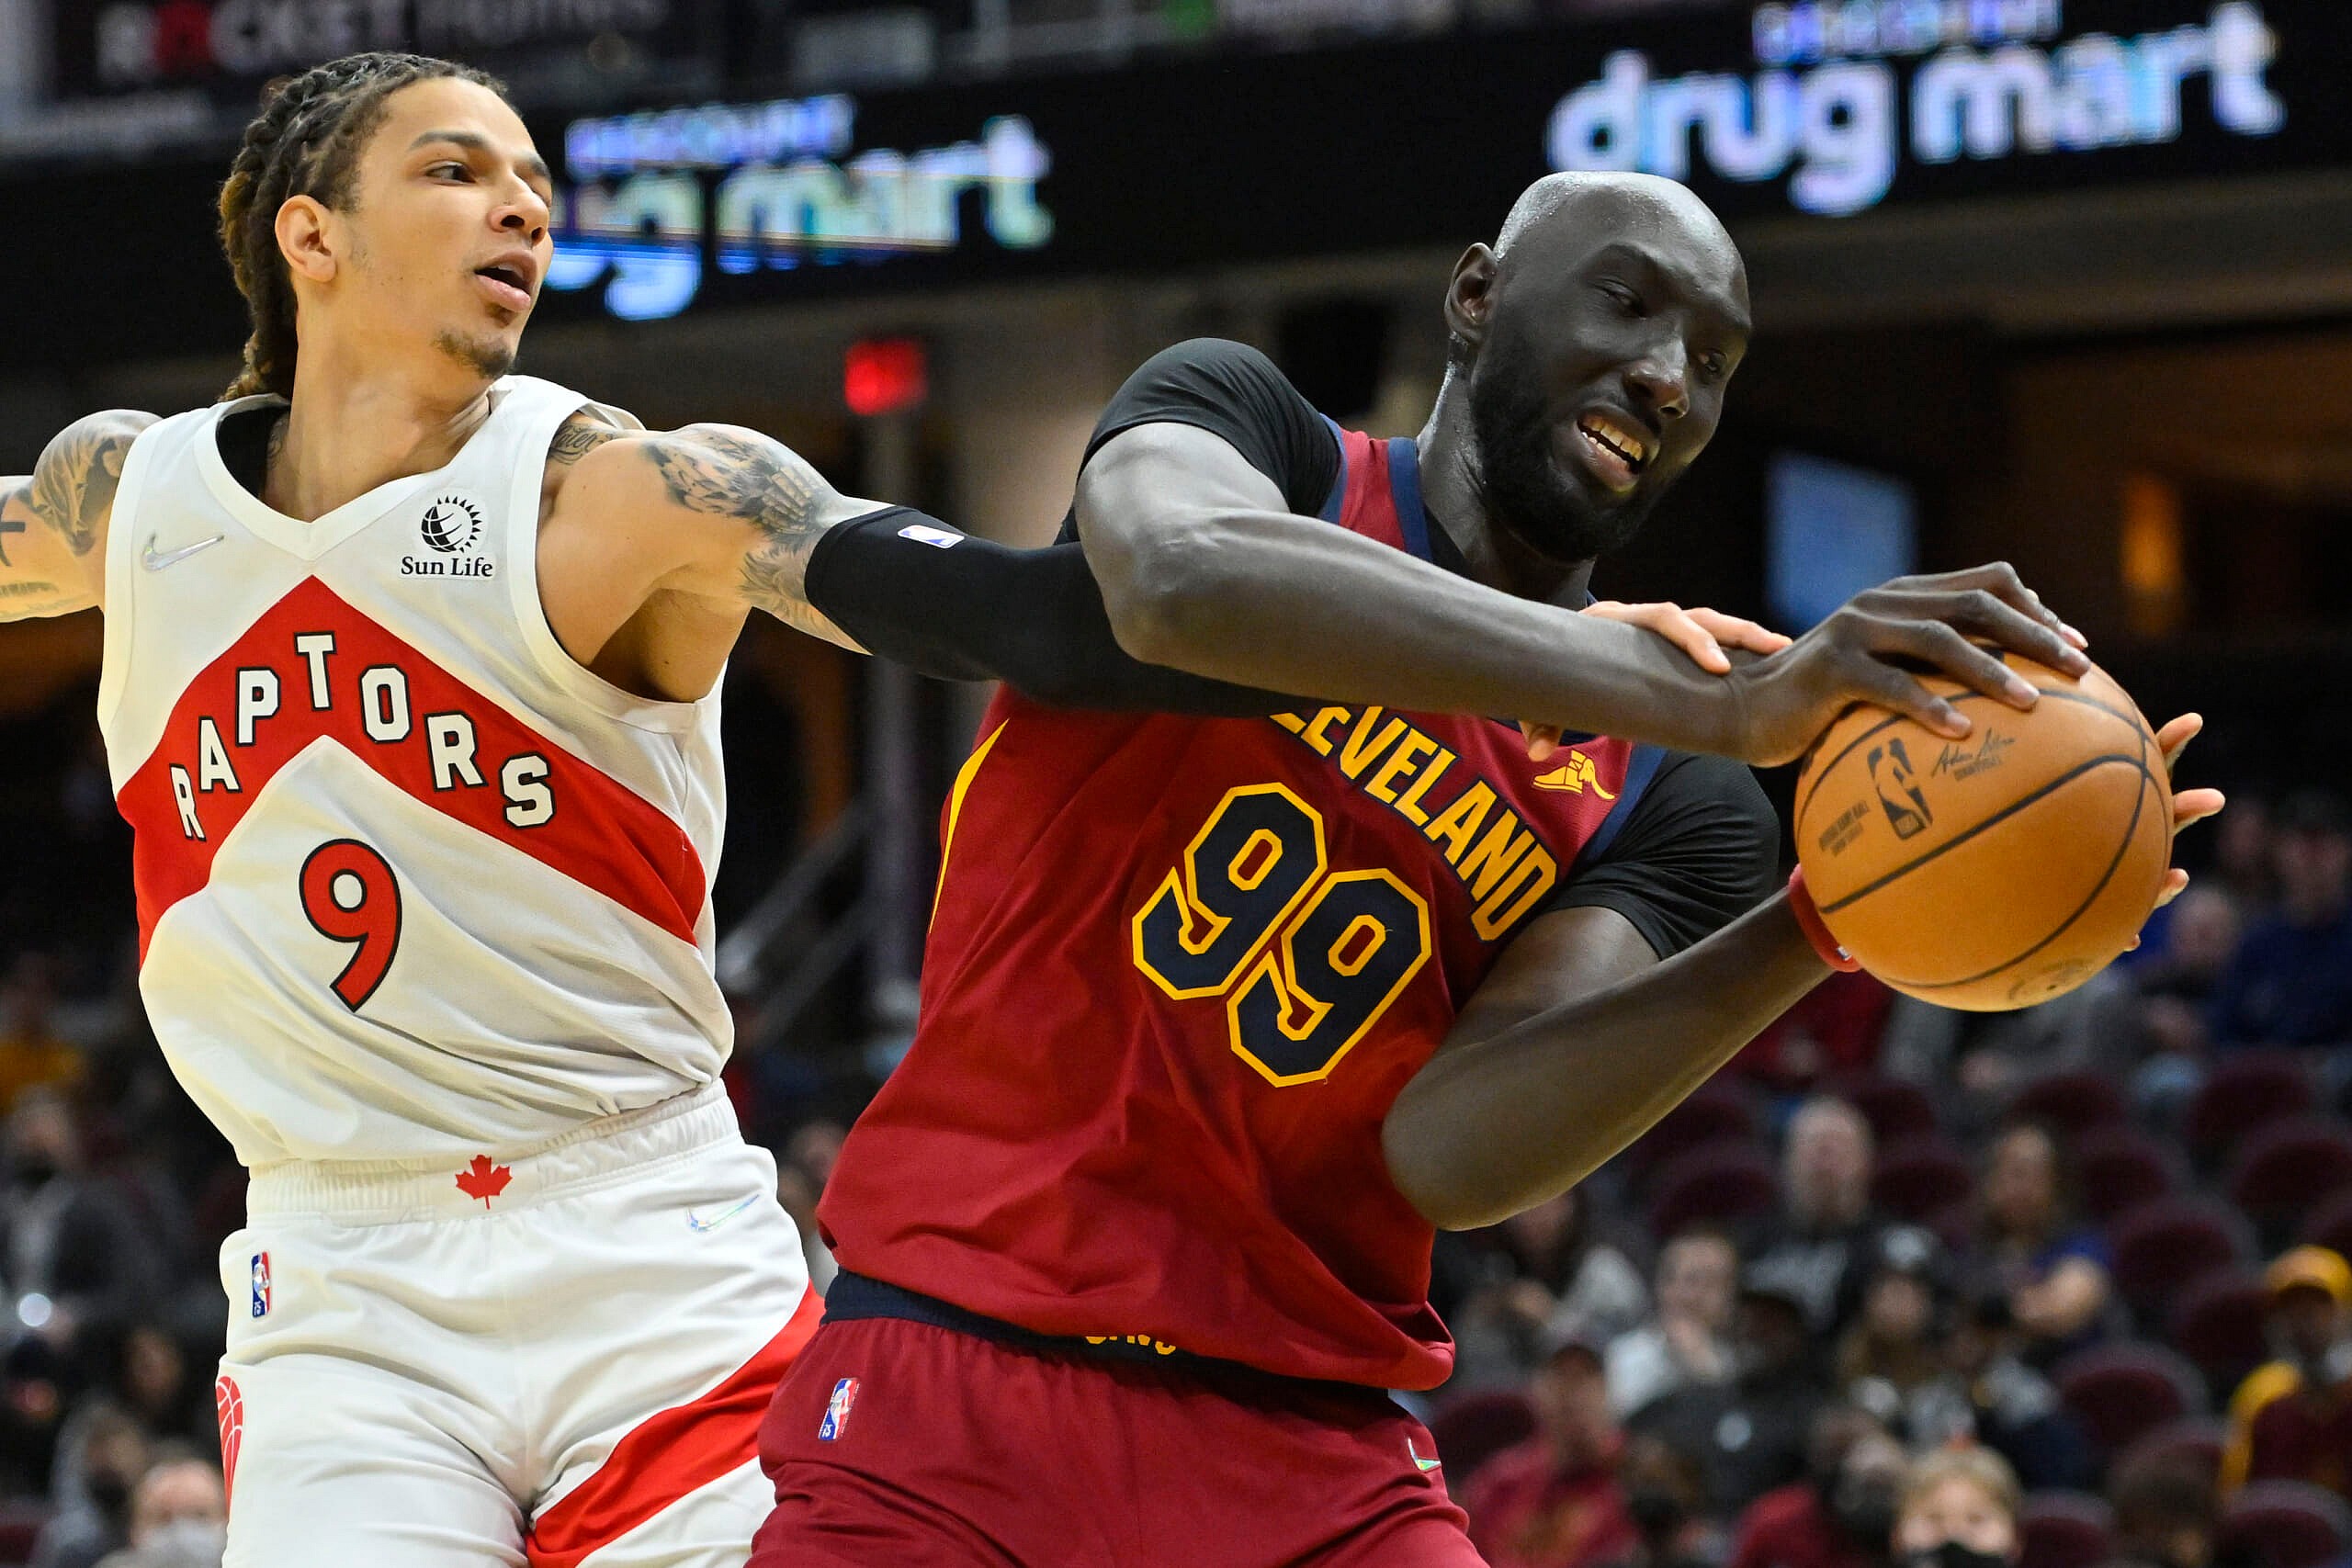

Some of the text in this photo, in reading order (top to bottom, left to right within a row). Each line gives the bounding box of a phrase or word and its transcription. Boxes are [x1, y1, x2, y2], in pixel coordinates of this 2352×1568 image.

[1544, 2, 2288, 217] drug mart
[542, 115, 1057, 320] ug mart
[401, 556, 493, 577] Sun Life
[169, 631, 555, 841] RAPTORS
[299, 838, 402, 1012] 9
[1131, 782, 1433, 1089] 99
